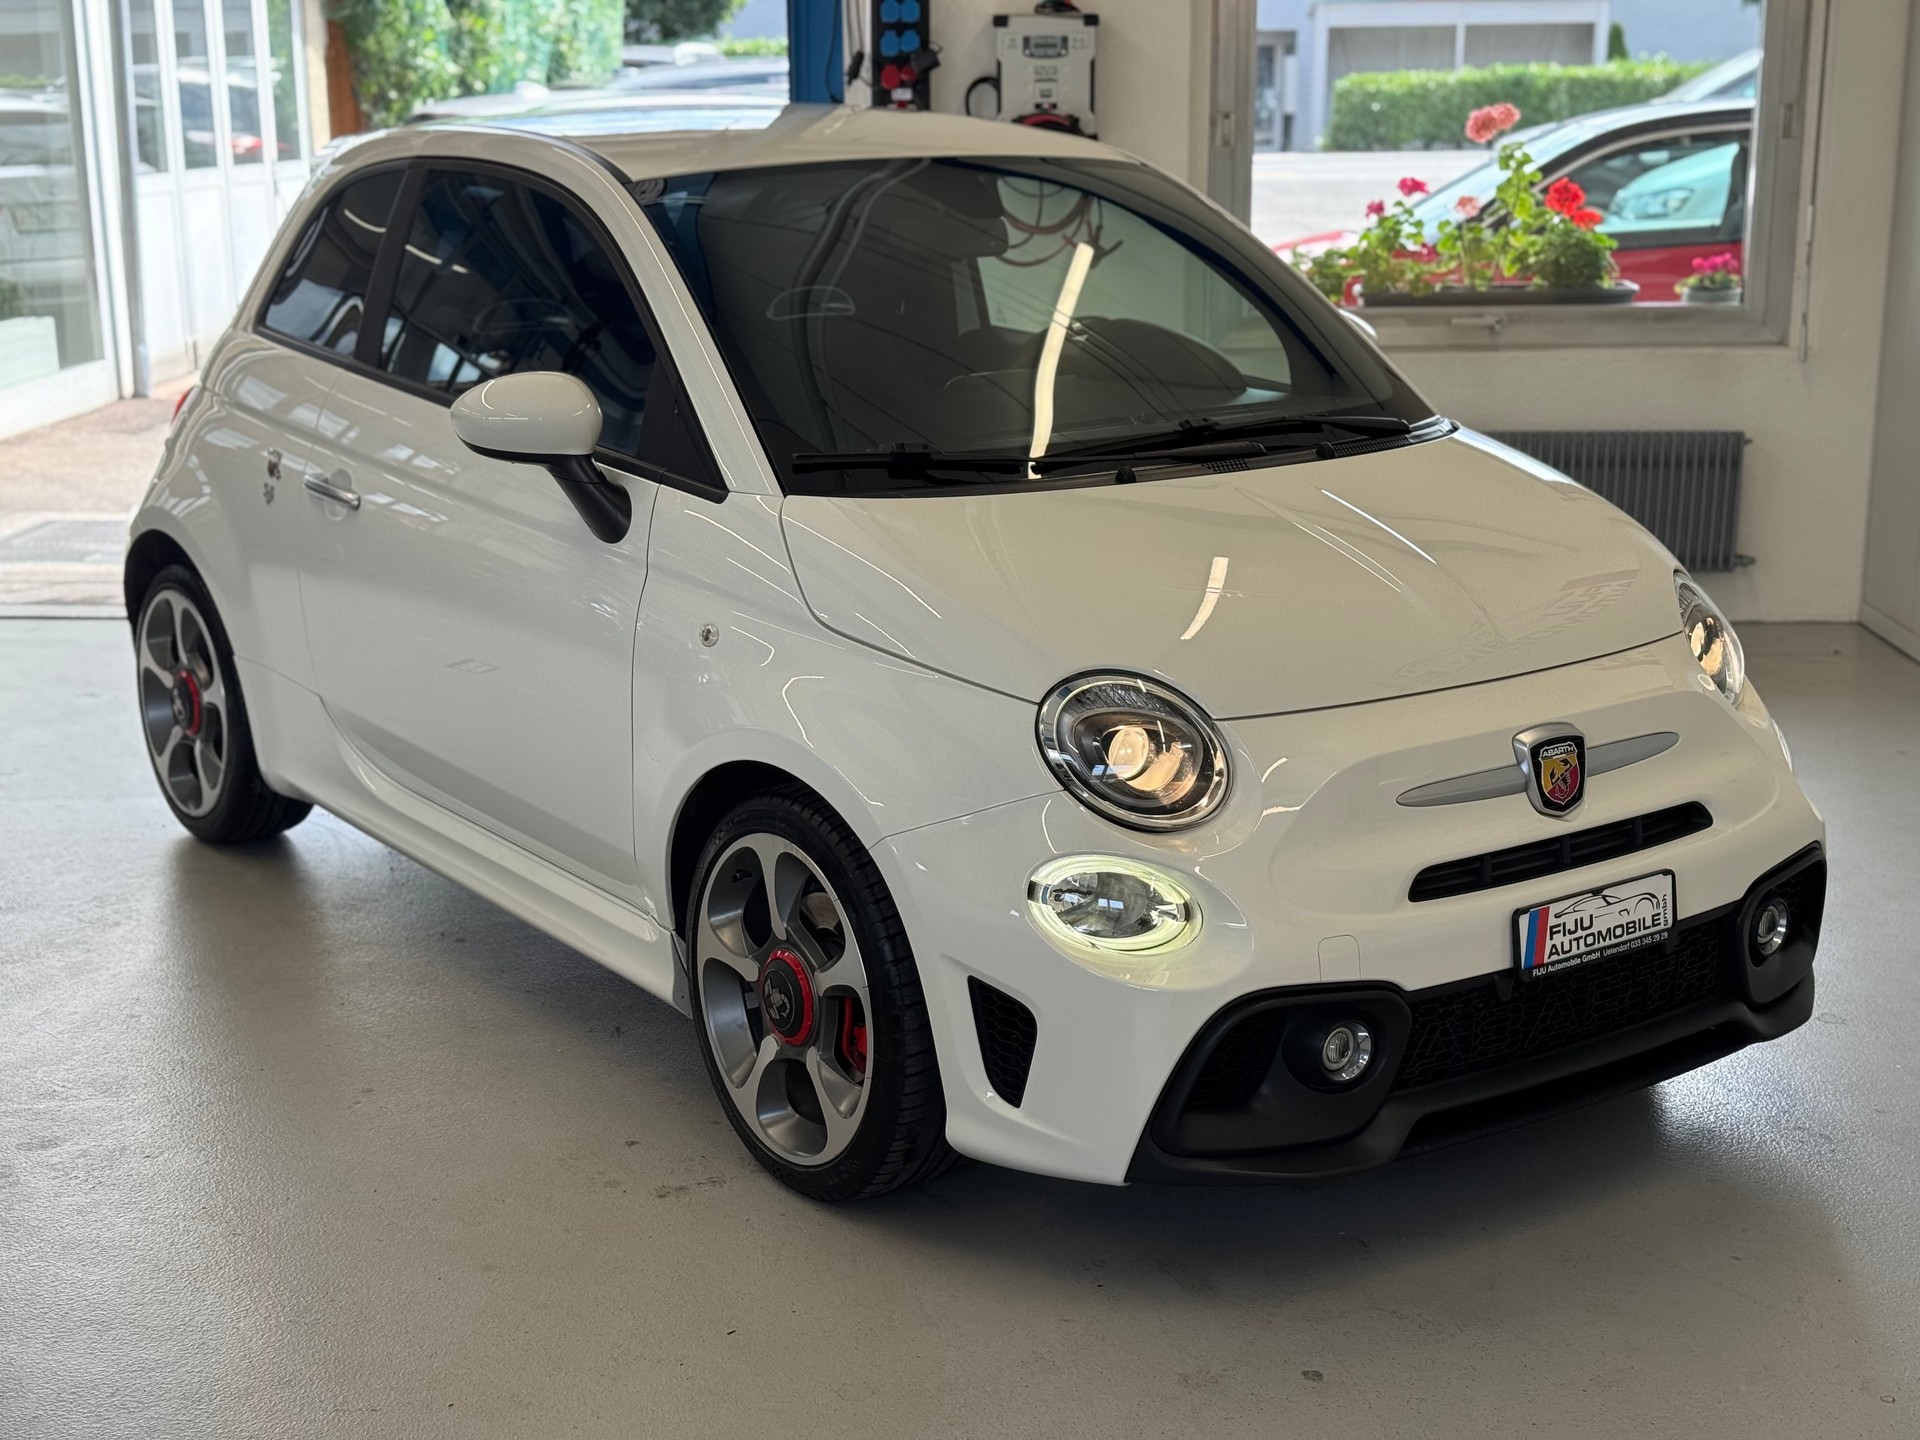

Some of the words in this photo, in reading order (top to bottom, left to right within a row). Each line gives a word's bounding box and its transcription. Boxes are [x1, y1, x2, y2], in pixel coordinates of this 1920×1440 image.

[1543, 746, 1573, 757] ABARTH
[1547, 912, 1662, 960] AUTOMOBILE
[1549, 914, 1594, 941] FIJU
[1532, 967, 1547, 977] FIJU
[1547, 957, 1582, 973] Automobile
[1582, 951, 1601, 963] GmbH
[1630, 939, 1642, 949] 033
[1642, 936, 1652, 946] 345
[1661, 931, 1669, 940] 29
[1404, 941, 1719, 1078] ABARTH
